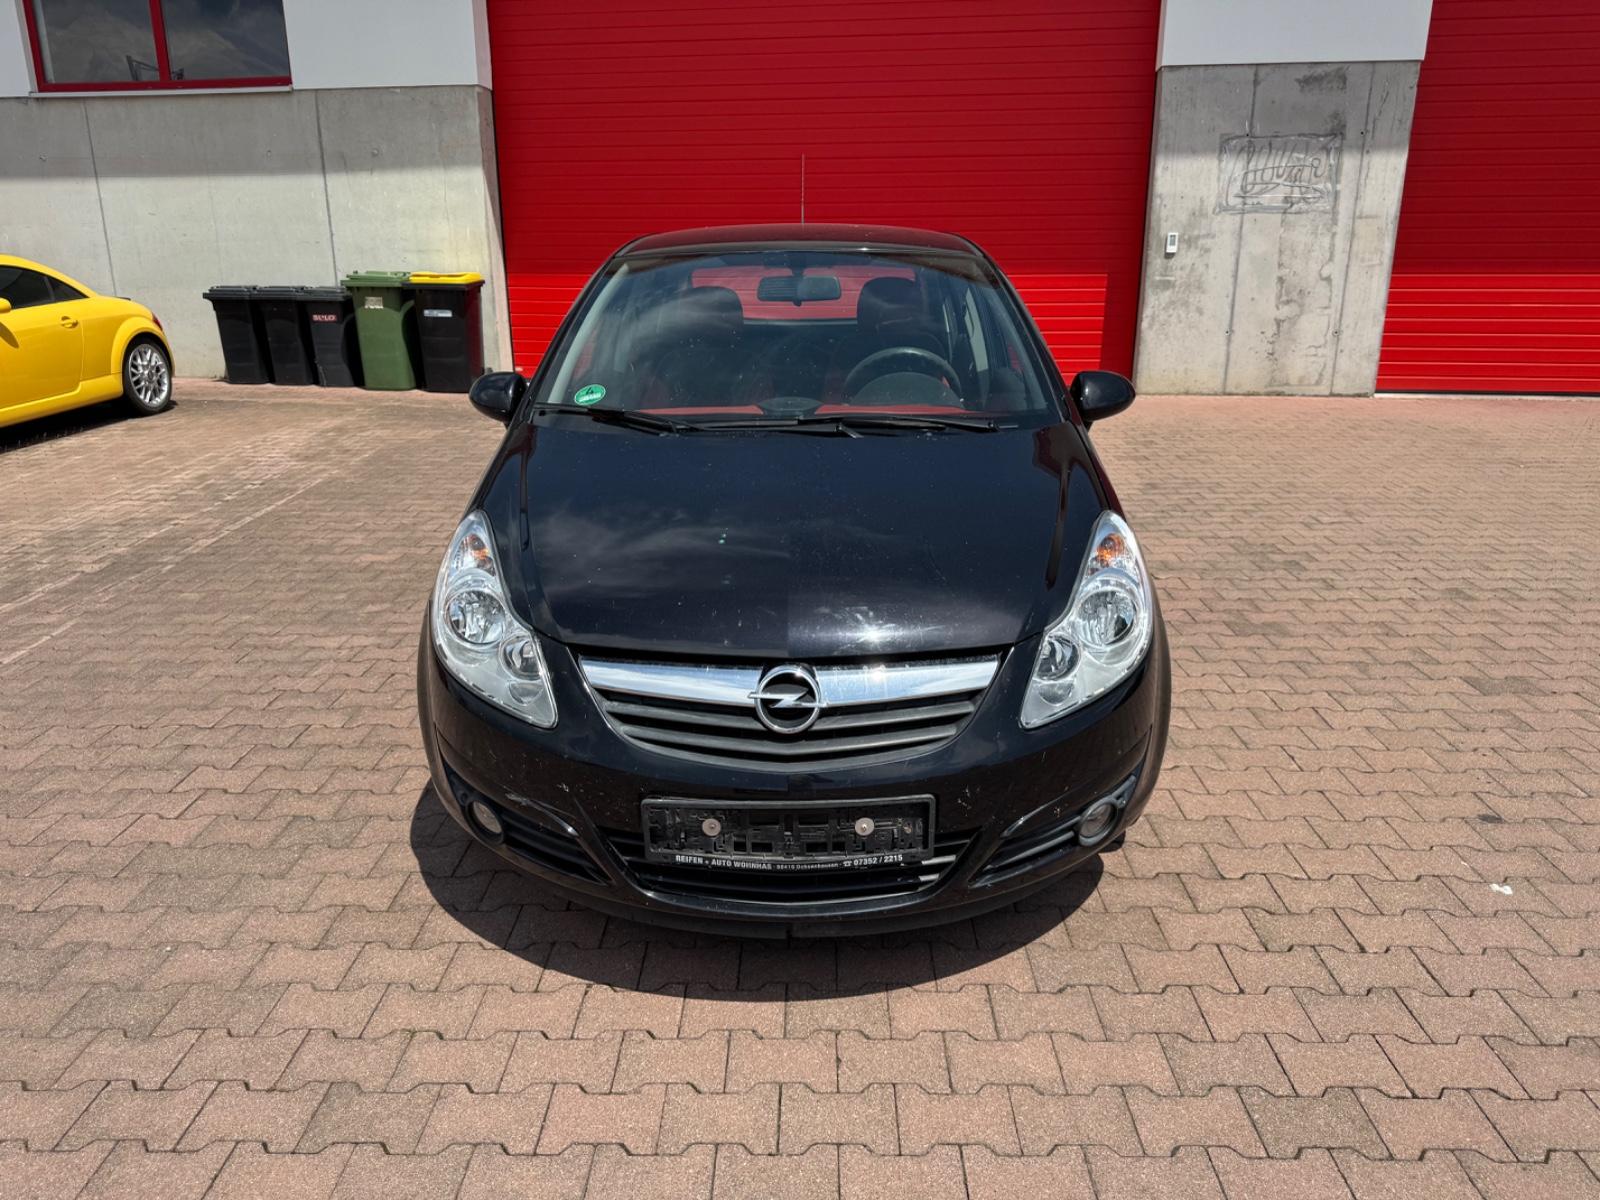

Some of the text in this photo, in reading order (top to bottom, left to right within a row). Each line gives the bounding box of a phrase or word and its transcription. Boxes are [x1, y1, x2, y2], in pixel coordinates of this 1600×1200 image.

[675, 854, 704, 864] REIFEN
[711, 859, 732, 867] AUTO
[853, 857, 877, 866] 07352
[883, 854, 903, 863] 2215
